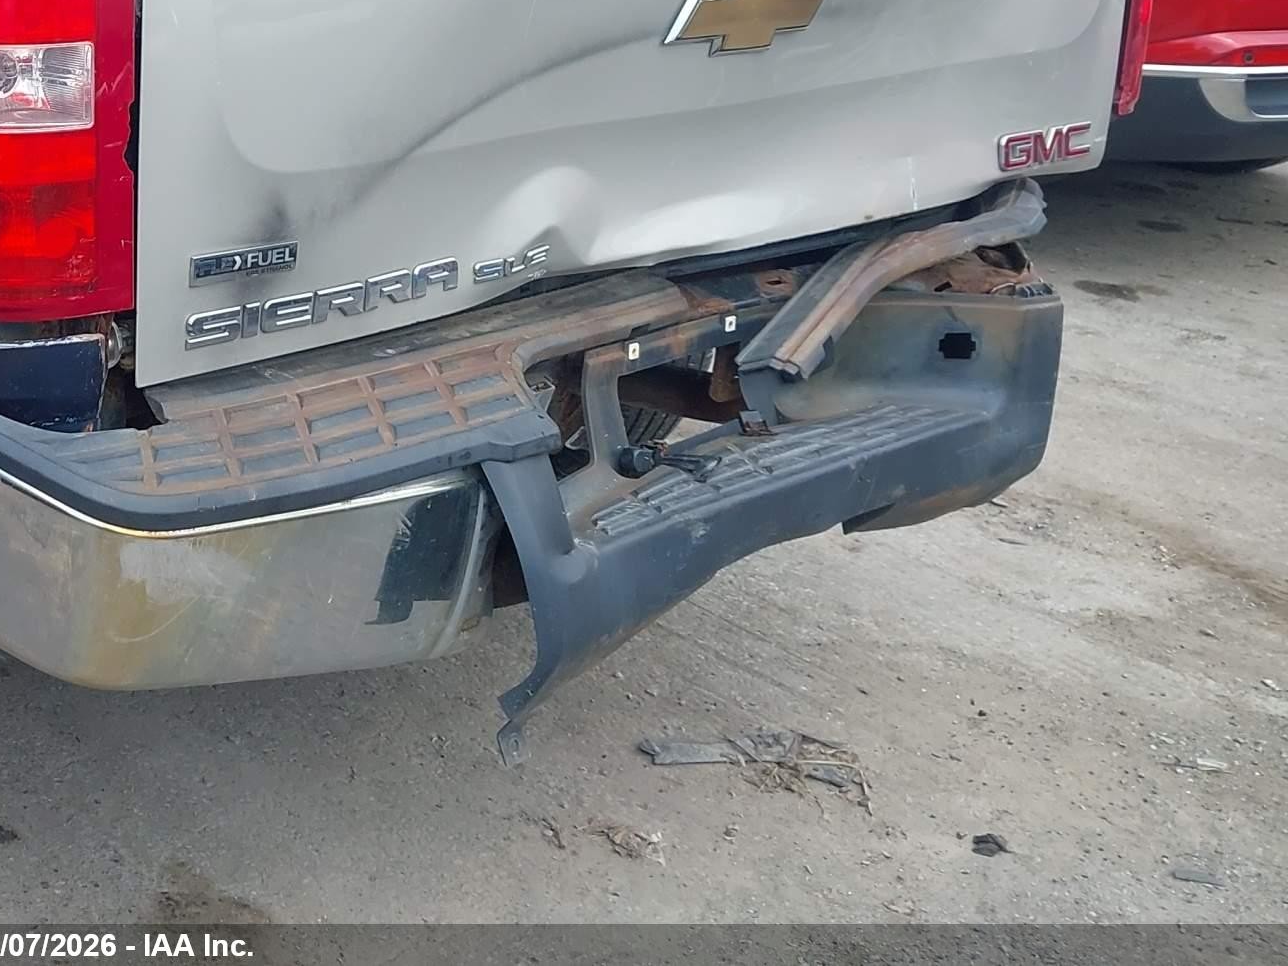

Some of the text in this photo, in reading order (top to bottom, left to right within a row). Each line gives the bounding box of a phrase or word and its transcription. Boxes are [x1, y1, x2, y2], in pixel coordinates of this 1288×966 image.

[997, 121, 1092, 172] GMC
[246, 247, 295, 268] FUEL
[185, 244, 550, 351] SIERRA SLE
